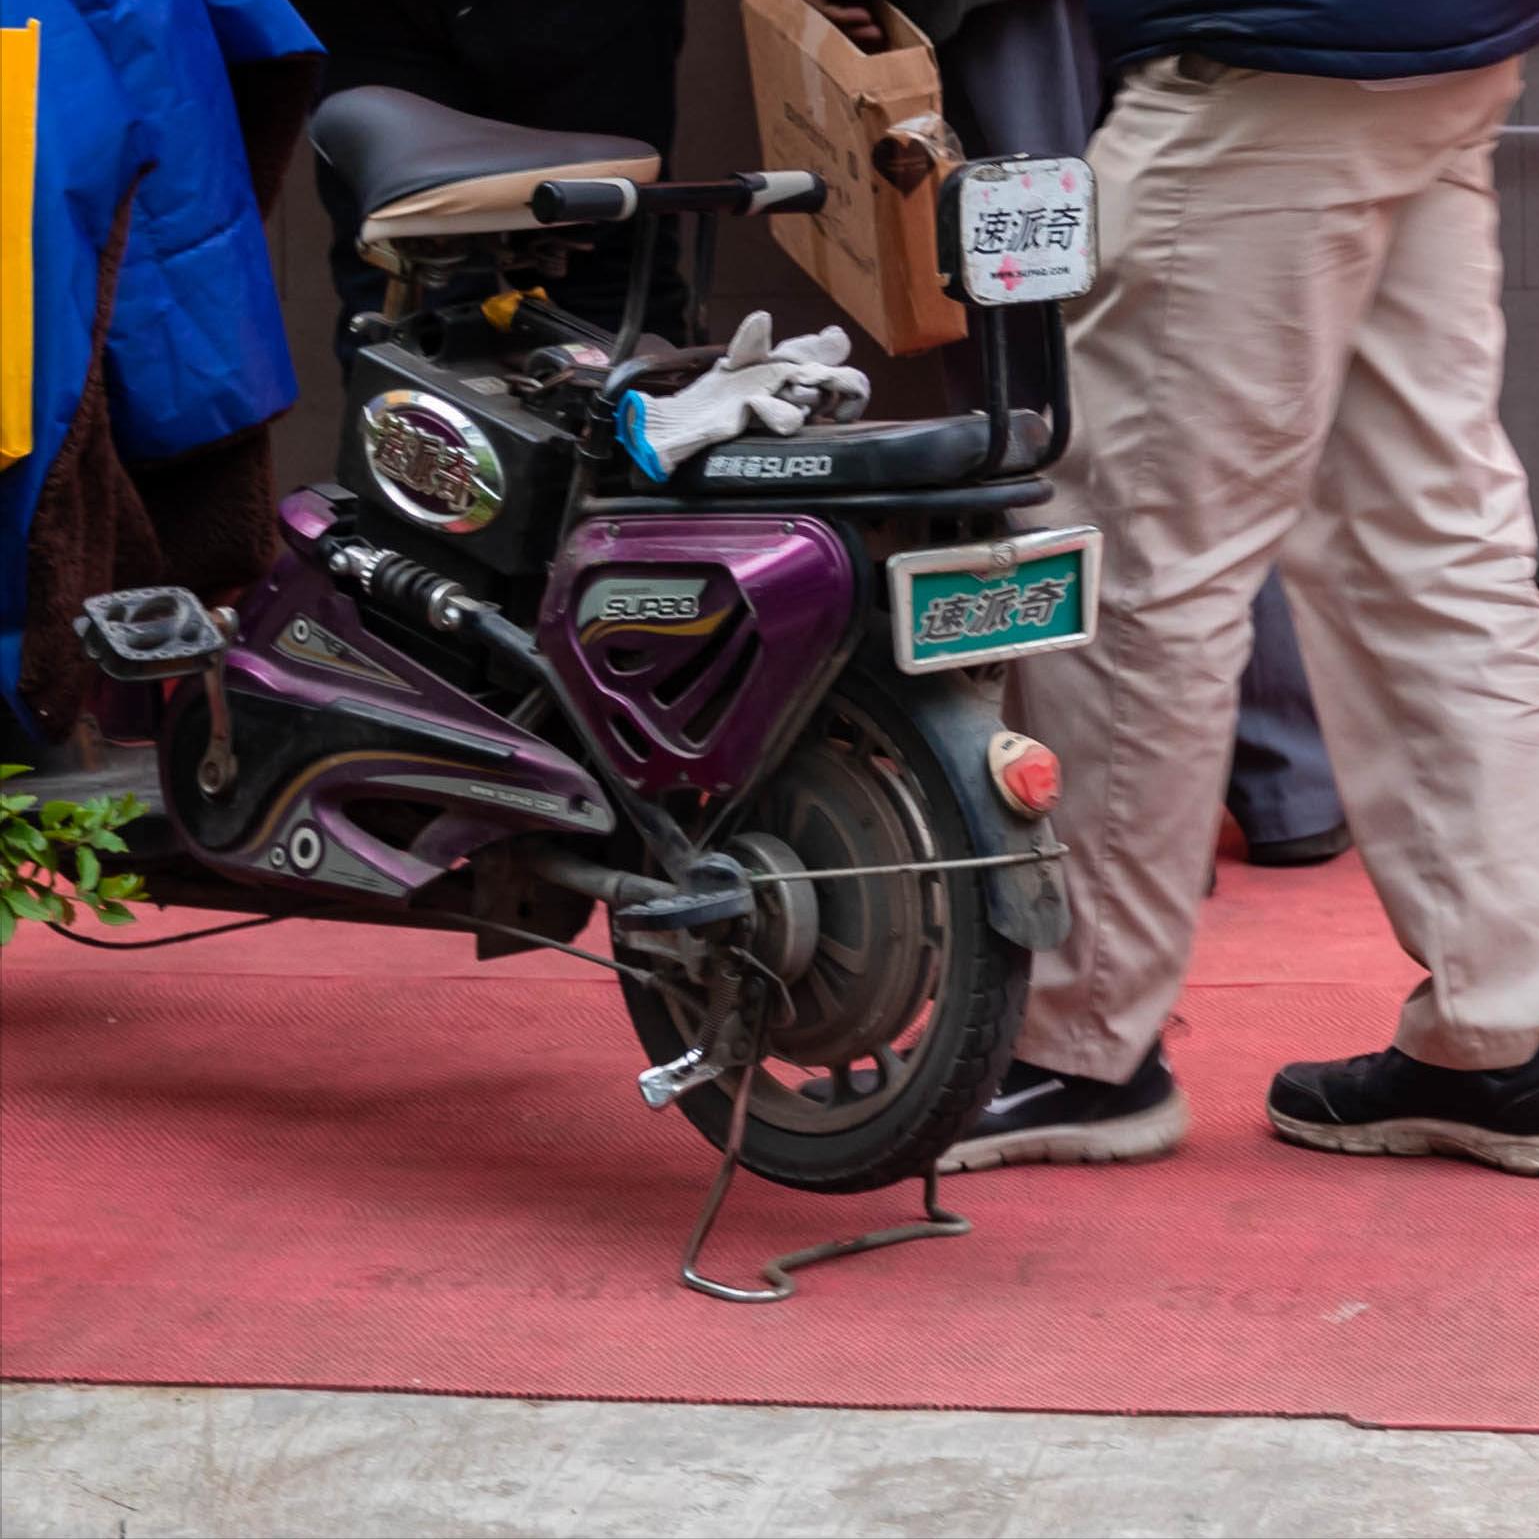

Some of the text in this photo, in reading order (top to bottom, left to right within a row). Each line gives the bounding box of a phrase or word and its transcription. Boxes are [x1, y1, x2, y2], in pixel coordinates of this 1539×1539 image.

[966, 204, 1083, 255] 速派奇
[915, 571, 1076, 645] 速派奇
